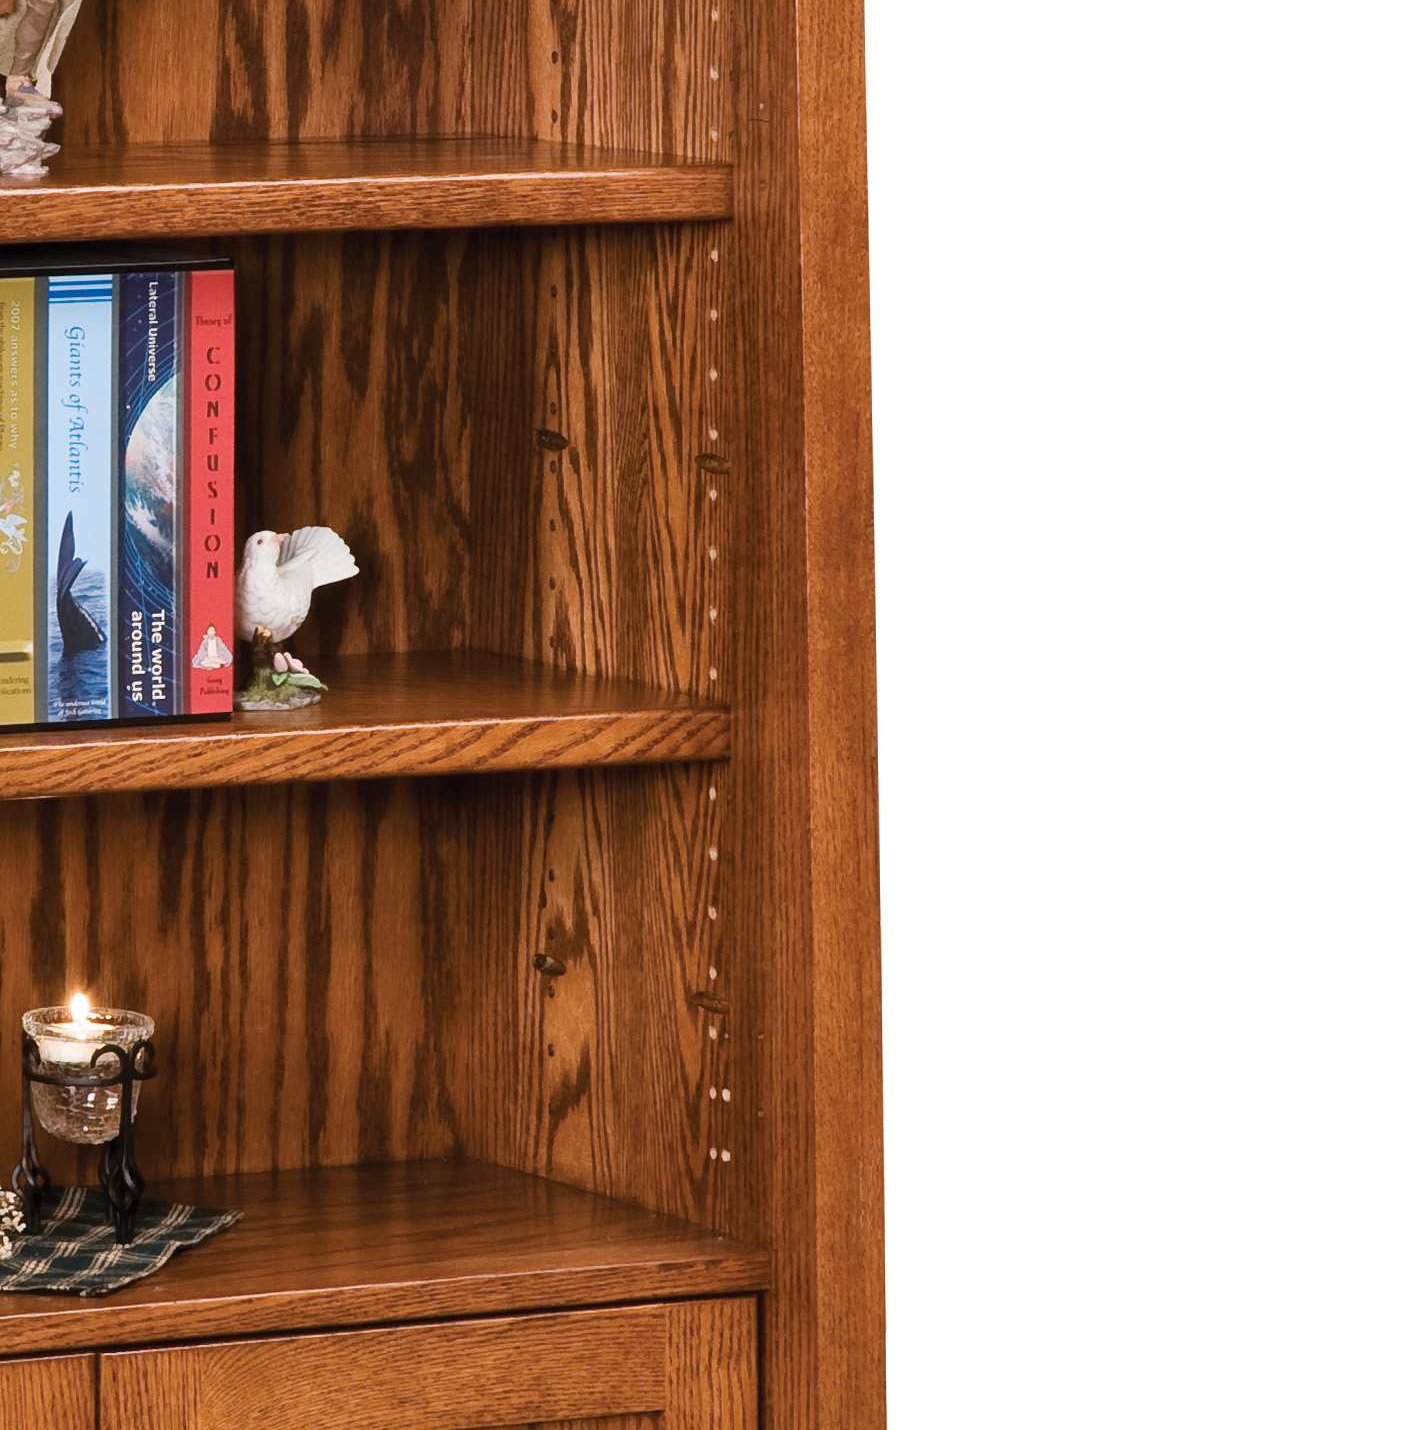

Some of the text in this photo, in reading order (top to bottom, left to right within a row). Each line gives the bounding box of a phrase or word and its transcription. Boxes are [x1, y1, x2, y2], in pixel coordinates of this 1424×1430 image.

[148, 282, 158, 382] Lateral Universe
[196, 316, 221, 327] Theory
[8, 301, 21, 449] 2007 answers as to why
[61, 326, 89, 493] Giants of Atlantis
[205, 347, 222, 579] CONFUSION
[131, 611, 145, 701] around us
[151, 609, 166, 700] The world
